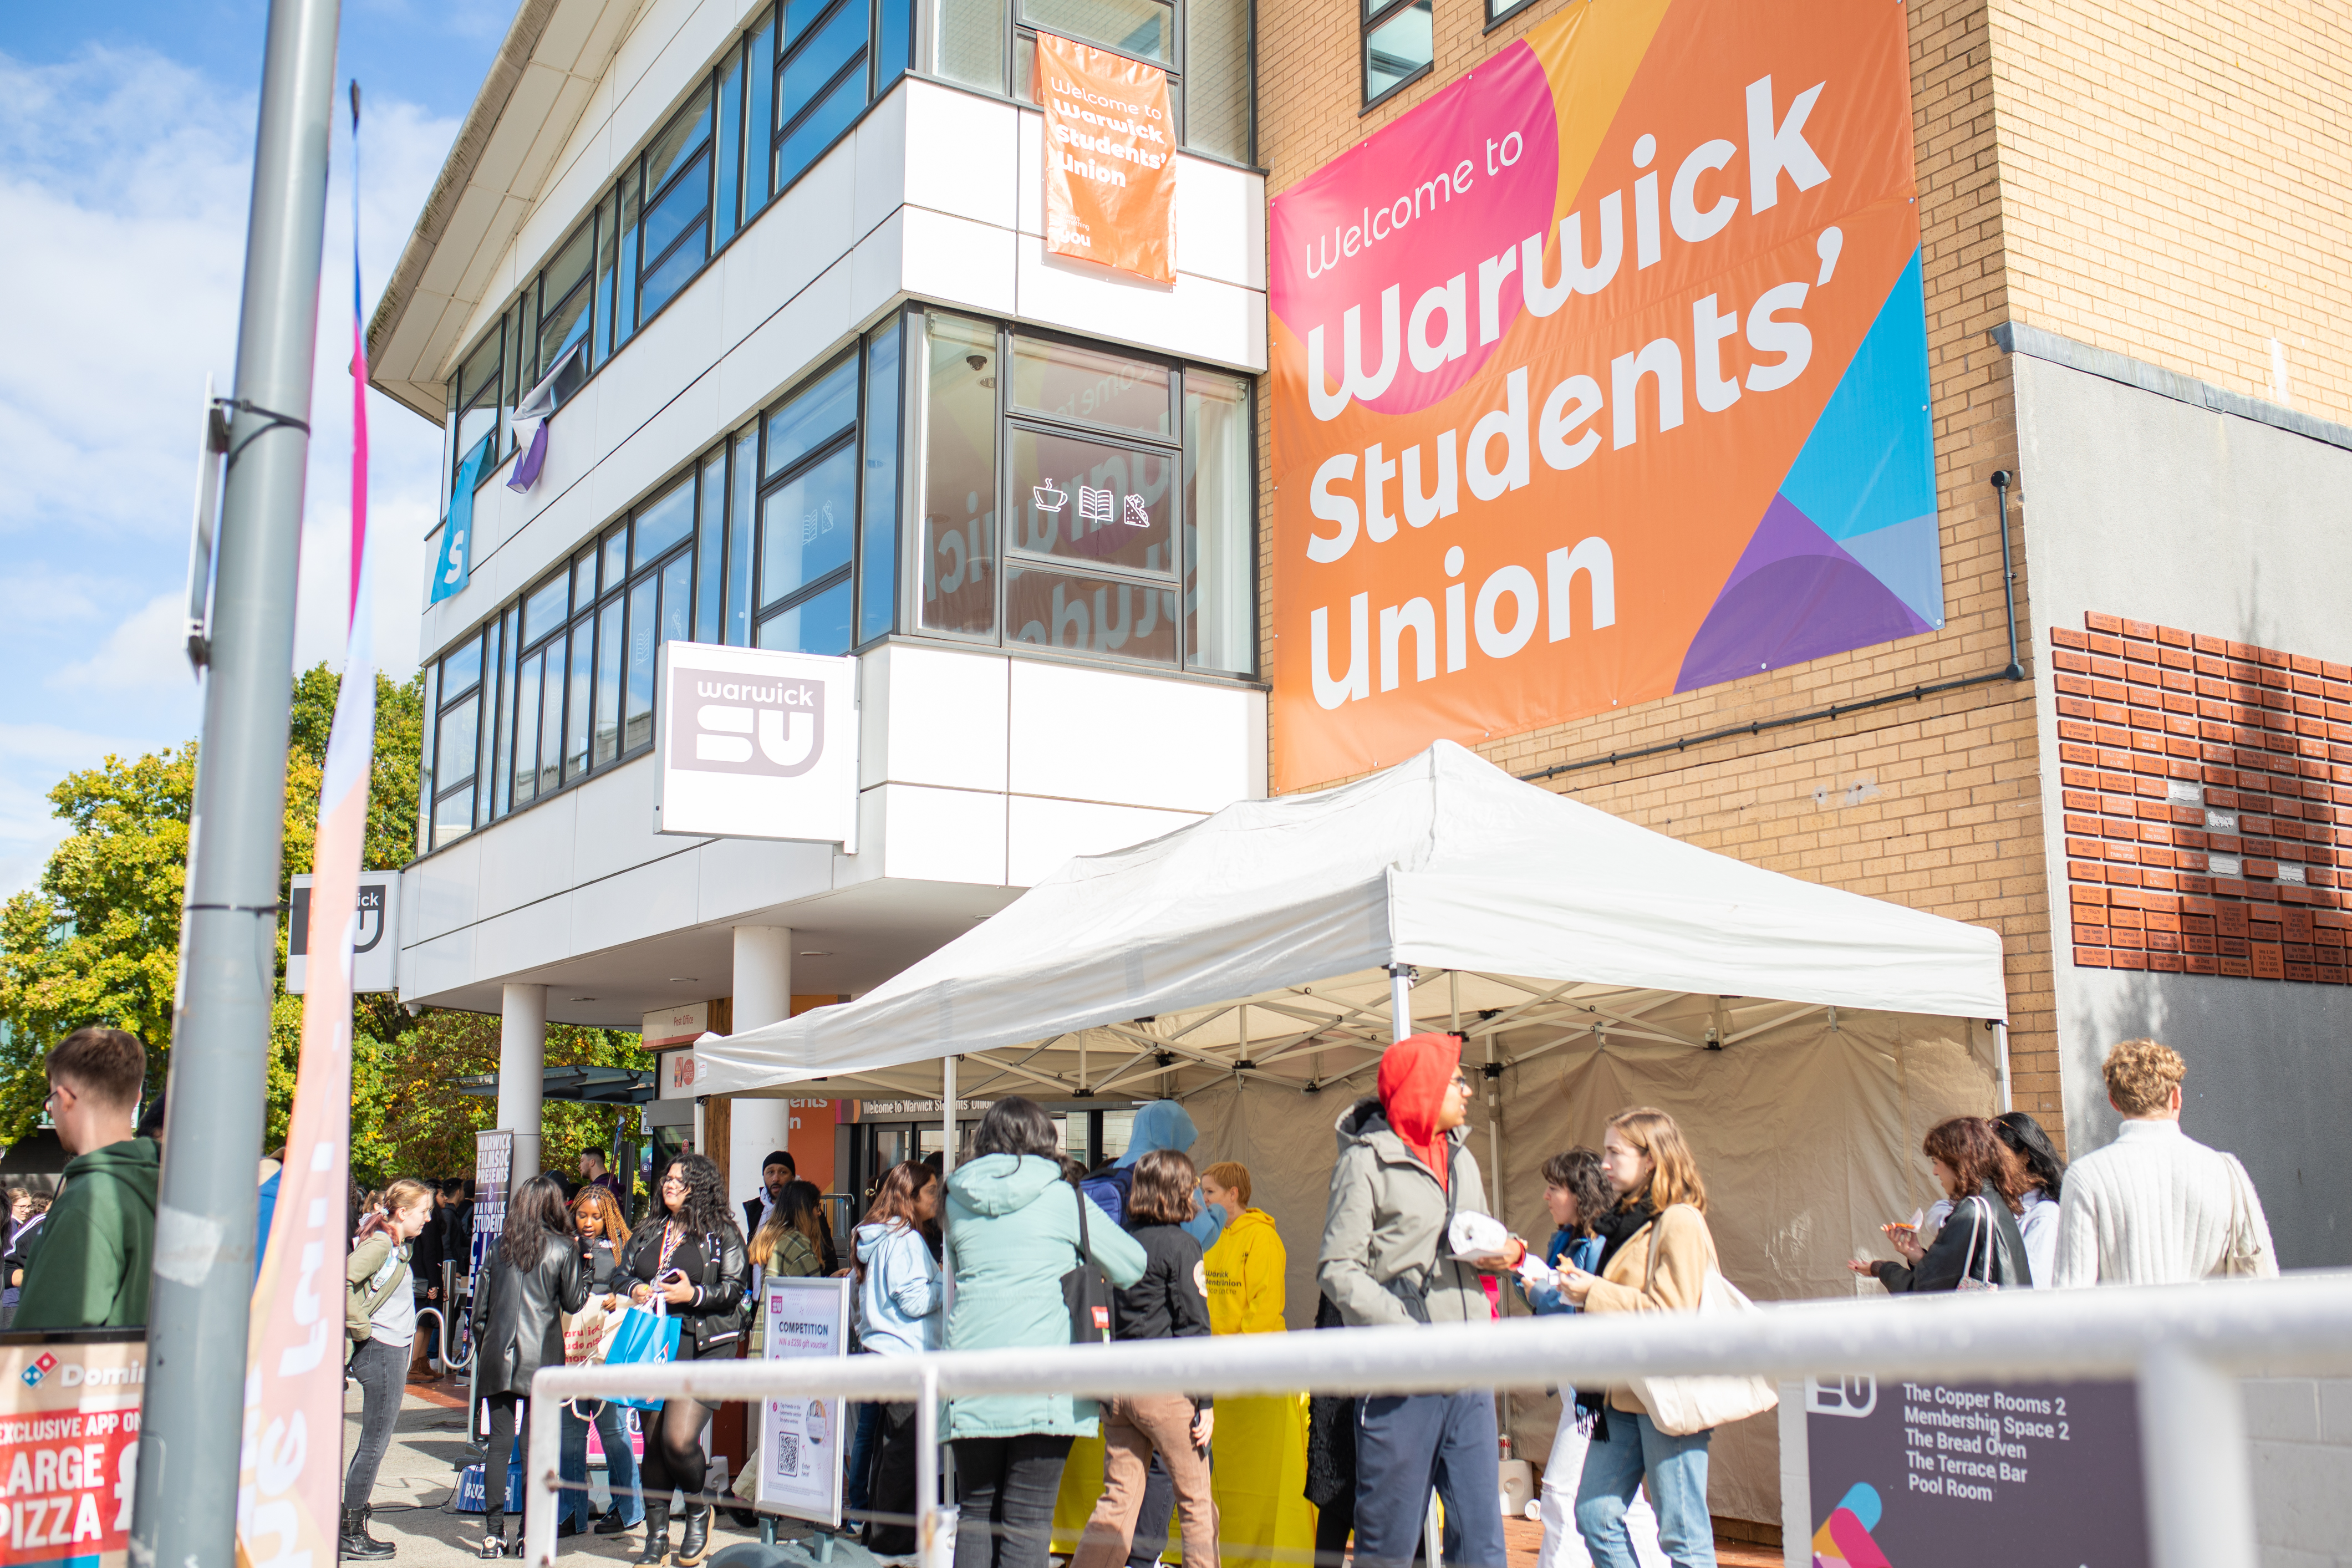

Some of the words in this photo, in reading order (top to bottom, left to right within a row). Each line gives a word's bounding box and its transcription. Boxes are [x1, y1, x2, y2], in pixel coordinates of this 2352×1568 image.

[1051, 77, 1139, 115] Welcome
[1145, 104, 1162, 120] to
[1053, 98, 1165, 144] Warwick
[1057, 151, 1126, 188] Union
[1305, 155, 1473, 280] Welcome
[1486, 130, 1524, 177] to
[1307, 73, 1832, 421] Warwick
[1310, 536, 1616, 710] Union
[697, 681, 814, 707] warwick
[696, 704, 814, 766] SU
[683, 1015, 693, 1025] Office
[863, 1101, 893, 1114] Welcome
[894, 1101, 902, 1113] to
[903, 1099, 933, 1113] Warwick
[477, 1134, 511, 1152] WARWICK
[477, 1149, 510, 1169] FILMSOC
[476, 1167, 509, 1184] PRESENTS
[474, 1202, 506, 1214] WARWICK
[472, 1214, 505, 1233] STUDENT
[779, 1321, 828, 1336] COMPETITION
[791, 1338, 801, 1347] £250
[810, 1341, 828, 1349] voucher!
[1903, 1383, 1931, 1403] The
[1934, 1386, 1990, 1411] Copper
[1994, 1392, 2051, 1416] Rooms
[2055, 1398, 2066, 1417] 2
[85, 1413, 119, 1437] APP
[1904, 1406, 1999, 1438] Membership
[2003, 1417, 2054, 1440] Space
[2058, 1422, 2070, 1440] 2
[1905, 1428, 1933, 1449] The
[1937, 1430, 1982, 1454] Bread
[1985, 1436, 2027, 1459] Oven
[0, 1443, 104, 1497] ARGE
[1906, 1450, 1934, 1471] The
[1937, 1454, 1995, 1479] Terrace
[2000, 1461, 2027, 1483] Bar
[1908, 1473, 1942, 1495] Pool
[1946, 1479, 1992, 1501] Room
